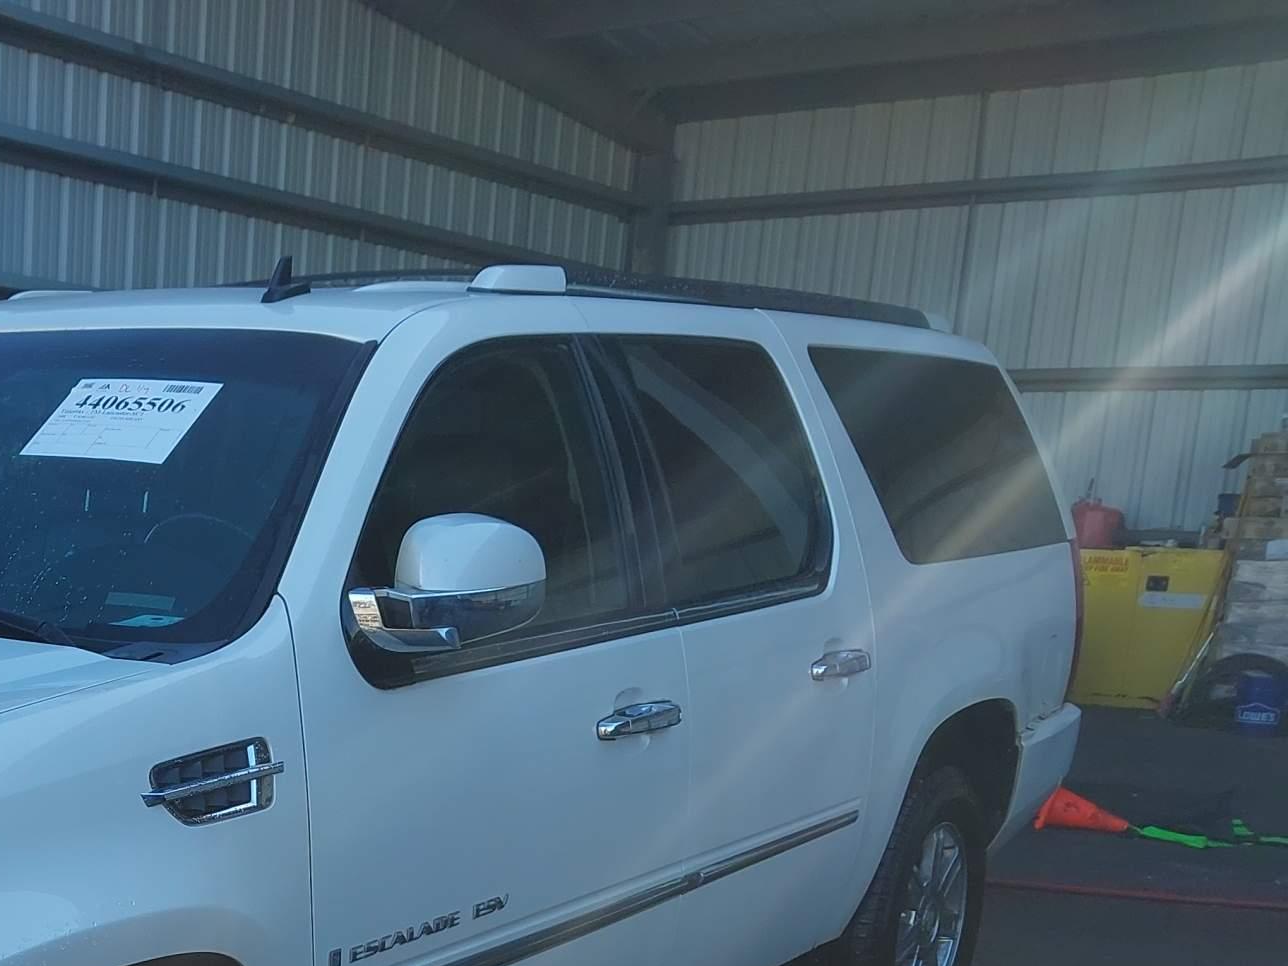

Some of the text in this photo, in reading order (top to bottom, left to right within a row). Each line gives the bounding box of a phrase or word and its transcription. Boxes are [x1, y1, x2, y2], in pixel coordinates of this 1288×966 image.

[75, 395, 192, 413] 44065506
[349, 893, 510, 964] ESCALADE ESV
